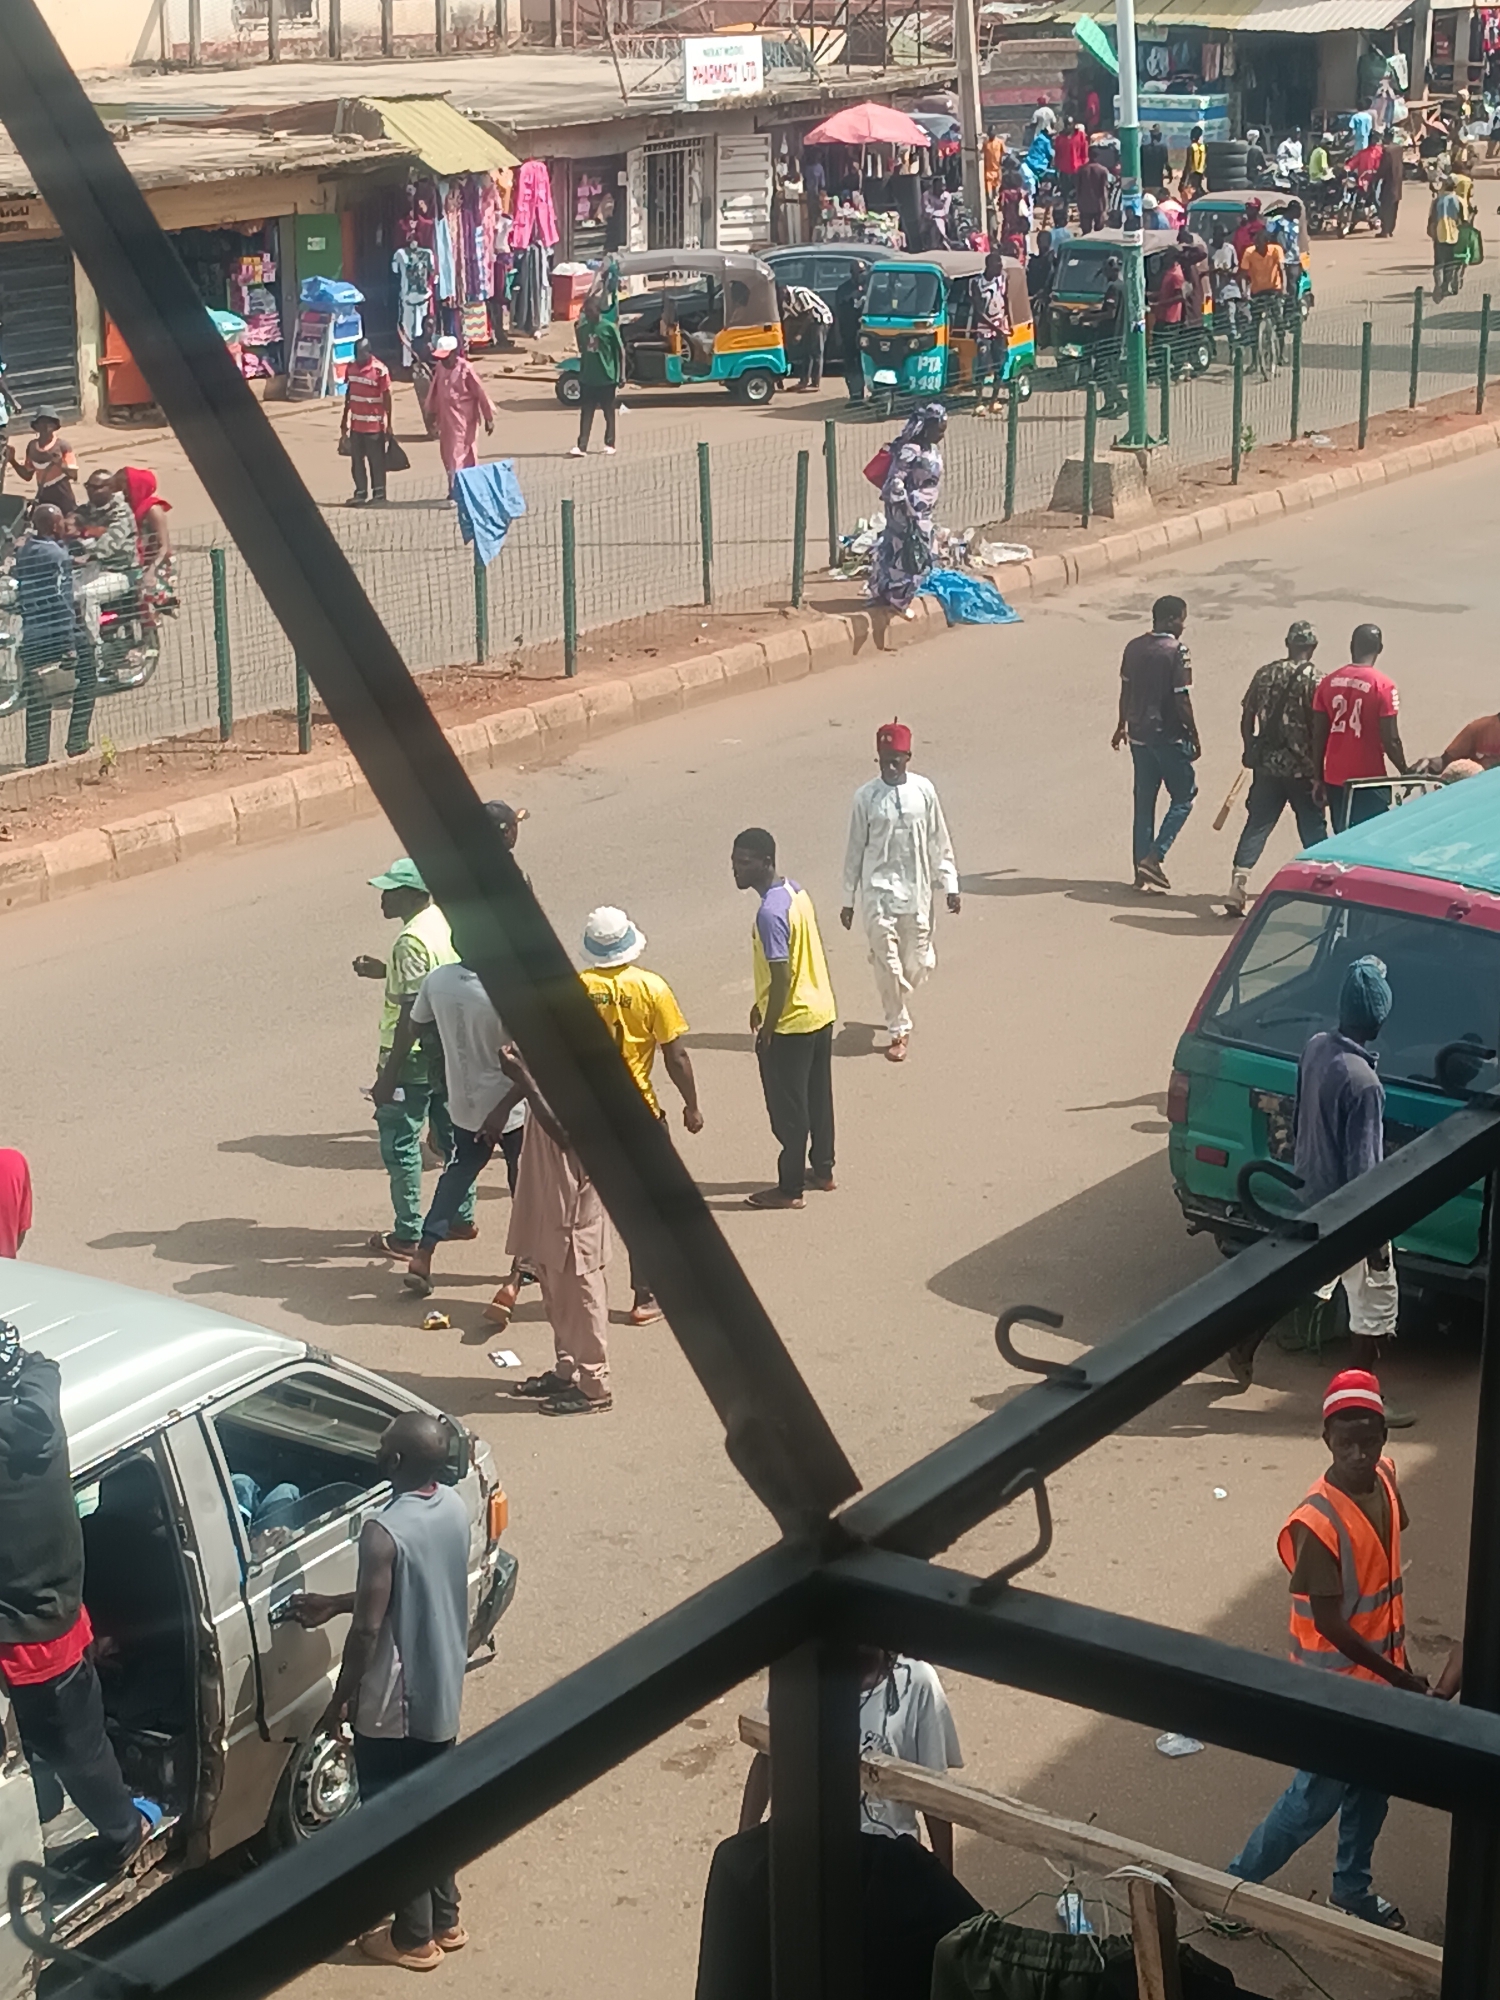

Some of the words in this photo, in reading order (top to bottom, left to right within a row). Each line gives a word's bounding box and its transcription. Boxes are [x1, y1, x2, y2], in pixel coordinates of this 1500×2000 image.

[692, 62, 738, 85] PHARMACY
[742, 61, 757, 82] LTD
[1330, 694, 1362, 739] 24
